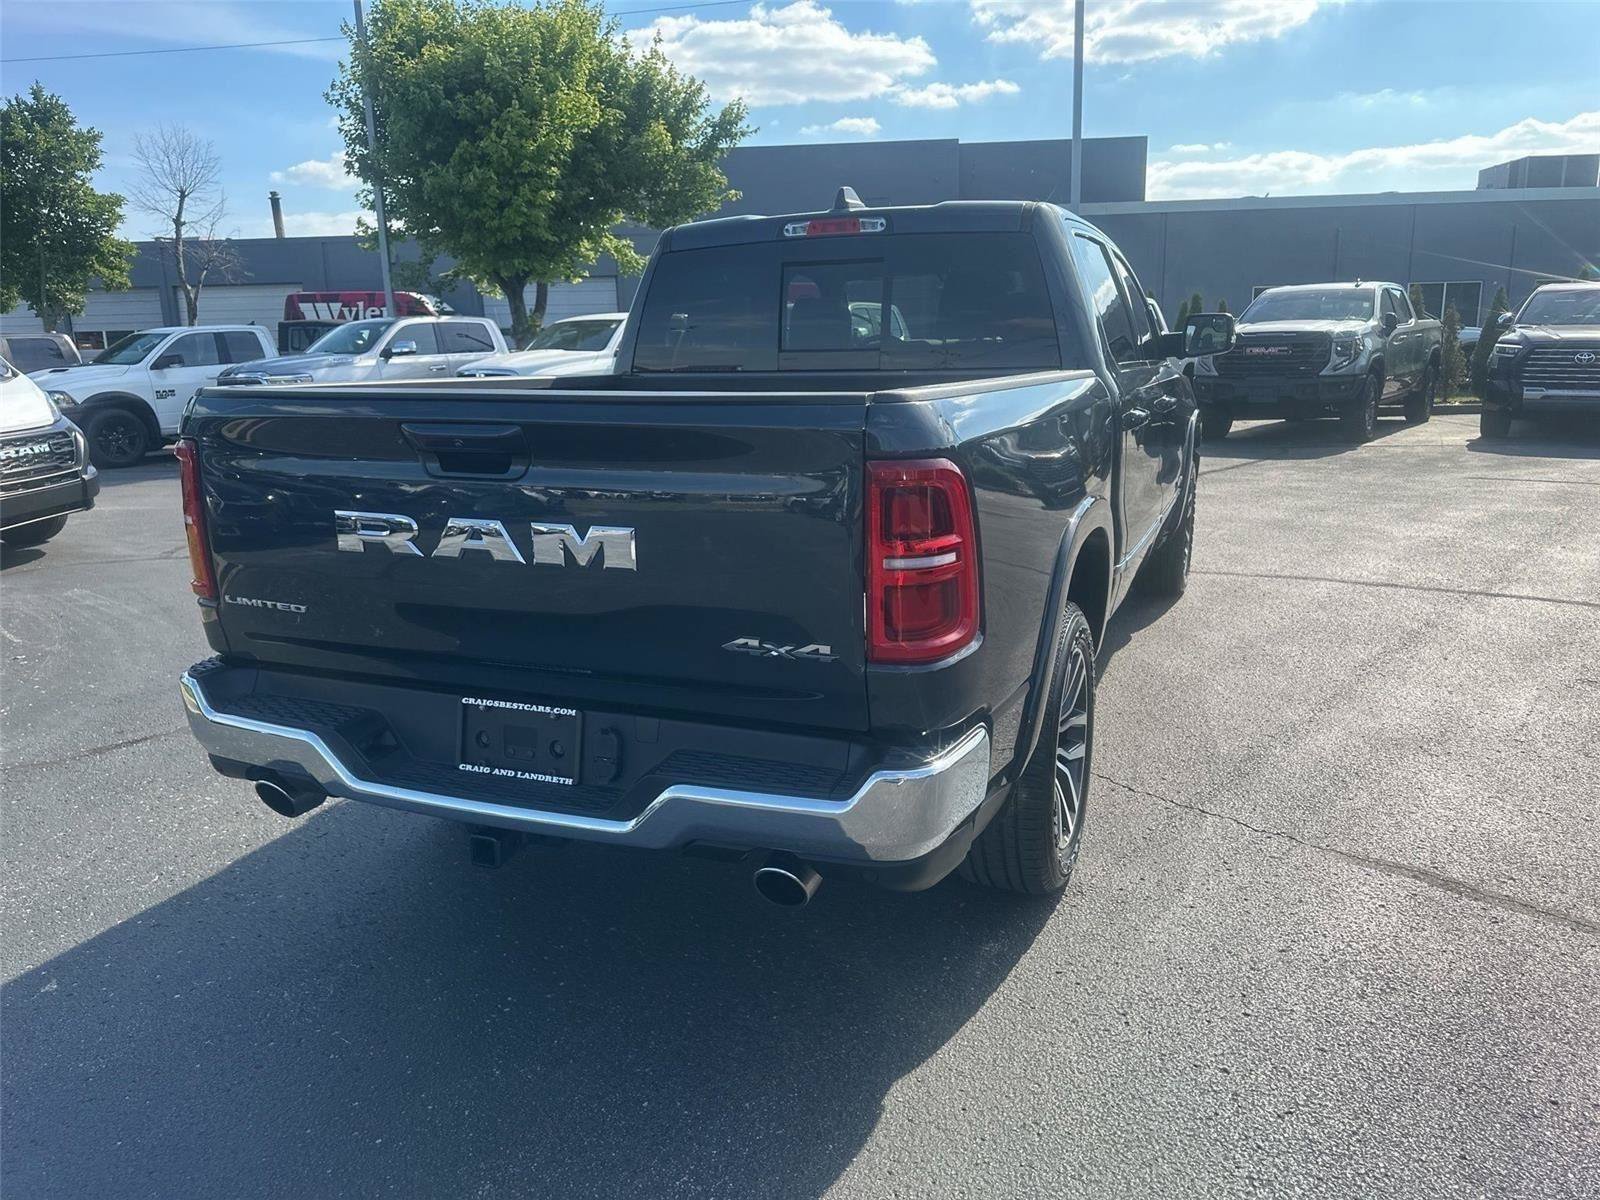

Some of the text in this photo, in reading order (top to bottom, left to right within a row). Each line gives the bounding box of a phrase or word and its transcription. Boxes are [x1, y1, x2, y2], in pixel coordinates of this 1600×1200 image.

[0, 443, 50, 460] RAM
[334, 509, 637, 572] RAM
[224, 594, 307, 613] LIMITED
[461, 697, 576, 716] CRAIGSBESTCARS.COM
[459, 763, 573, 785] CRAIG AND LANDRETH
